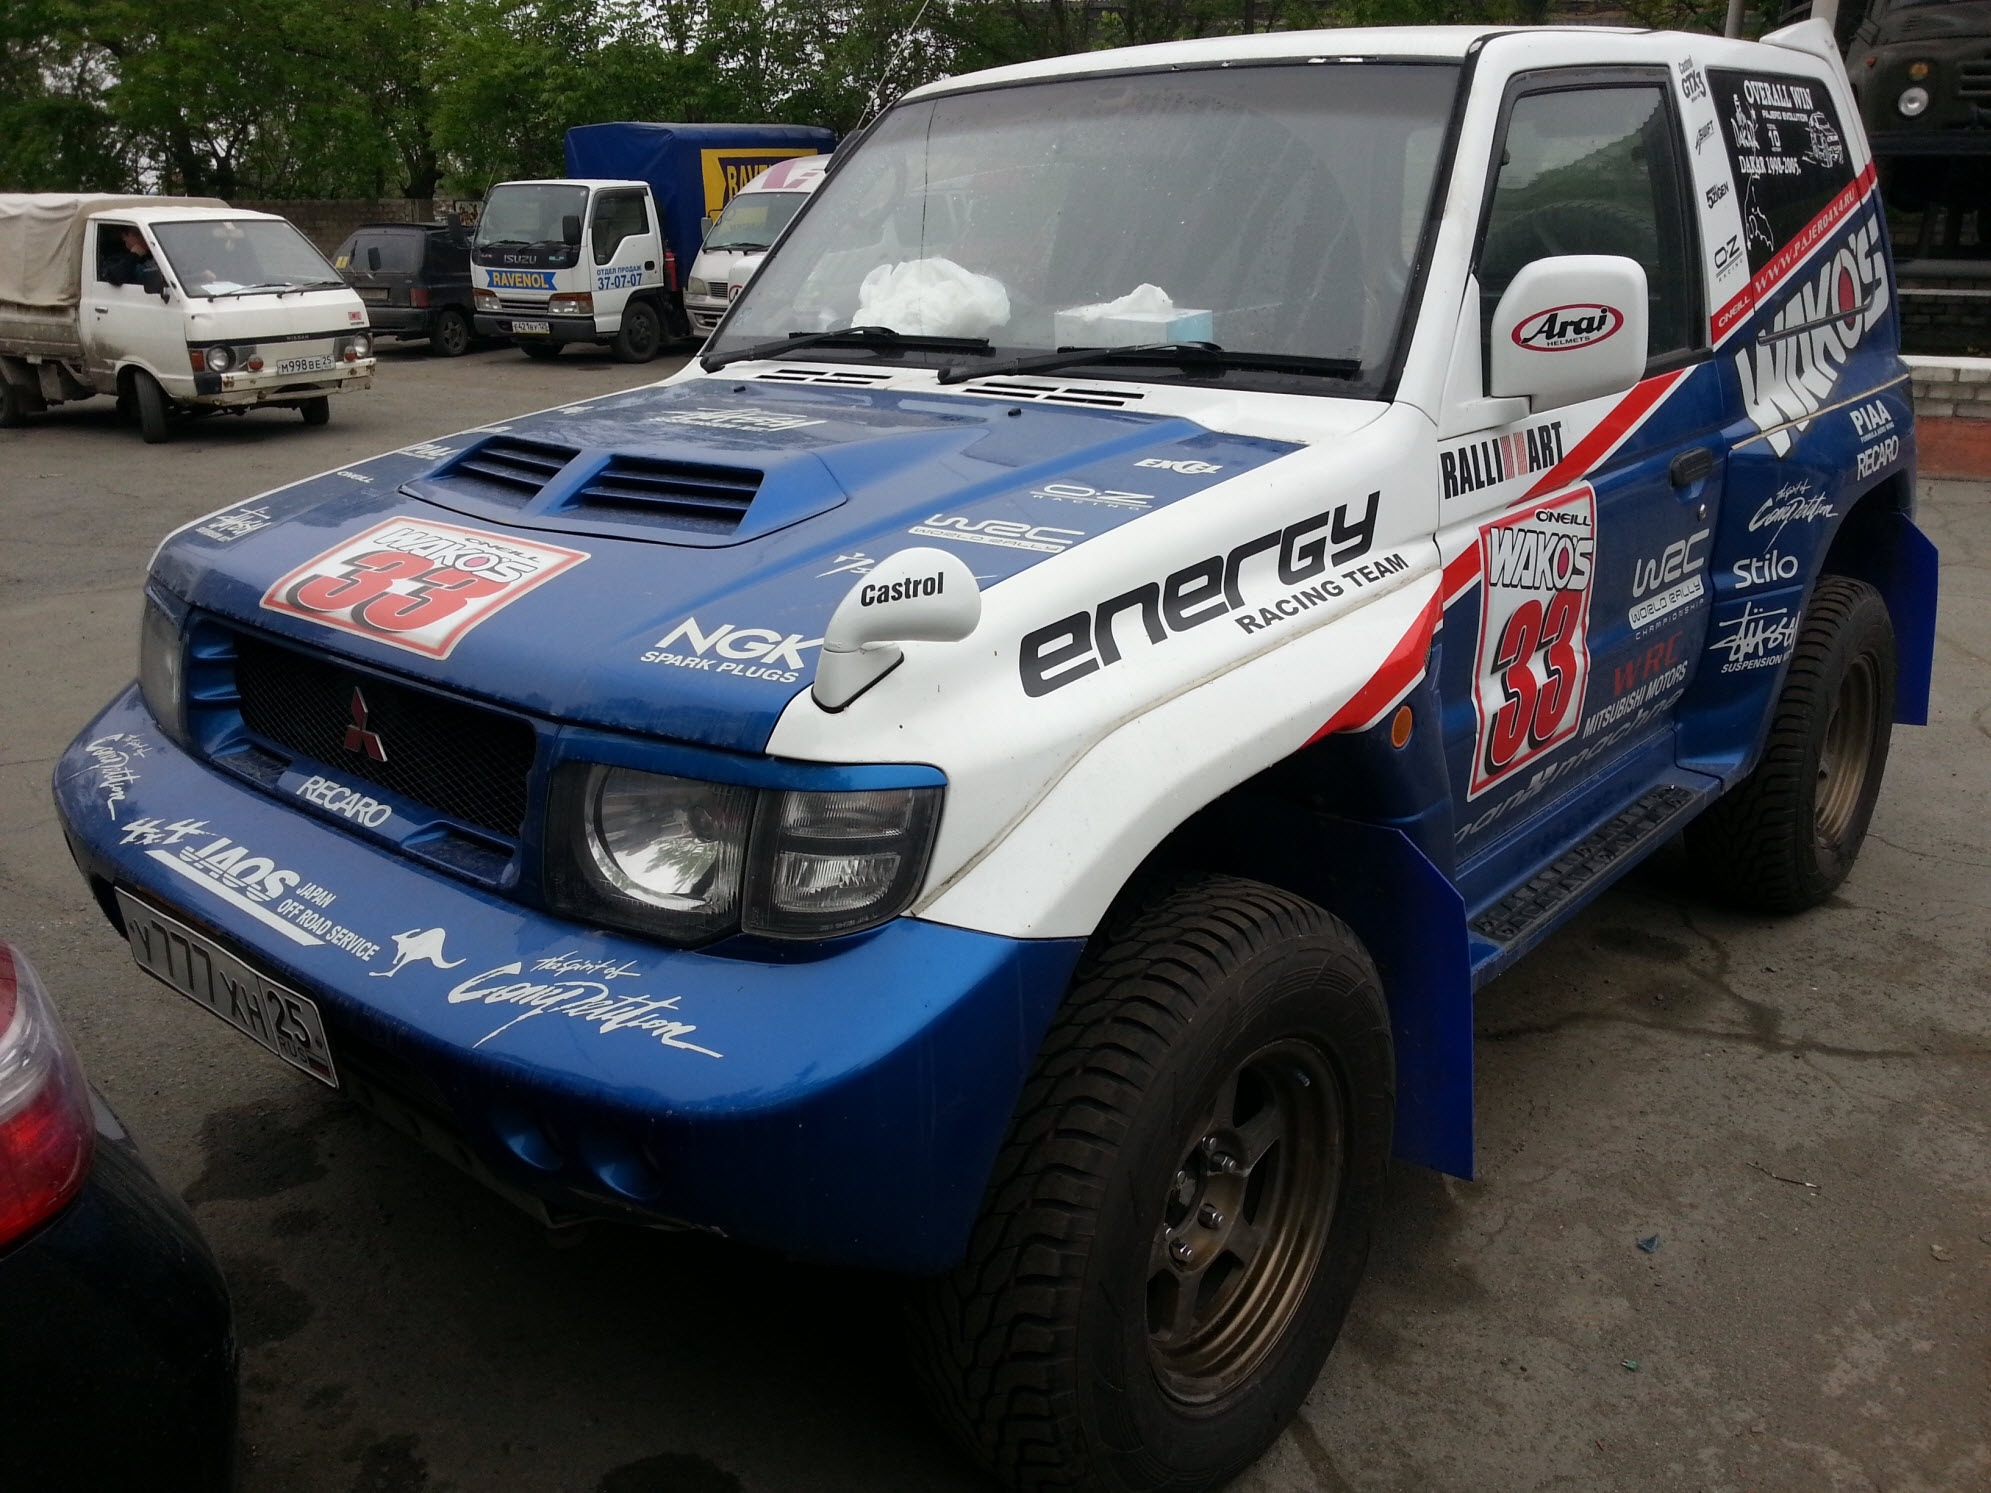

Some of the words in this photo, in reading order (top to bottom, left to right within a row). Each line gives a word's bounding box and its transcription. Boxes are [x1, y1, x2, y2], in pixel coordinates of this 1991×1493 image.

[1743, 80, 1792, 108] OVERALL
[1792, 87, 1814, 110] WIN
[1768, 130, 1781, 147] 10
[1738, 155, 1766, 174] DAKAR
[504, 254, 537, 265] ISUZU
[597, 267, 617, 276] ОТДЕЛ
[617, 264, 642, 275] ПРОДАЖ
[492, 271, 550, 289] RAVENOL
[597, 272, 643, 291] 37-07-07
[1521, 307, 1608, 344] Arai
[1546, 335, 1591, 347] HELMETS
[322, 356, 332, 365] 25
[1849, 400, 1892, 436] PIAA
[1857, 435, 1899, 480] RECARO
[914, 527, 984, 542] WORLD
[988, 538, 1061, 552] RALLY
[924, 514, 1085, 545] WRC
[1488, 526, 1594, 592] WAKO'S
[1632, 528, 1710, 598] WRC
[1733, 549, 1799, 589] Stilo
[286, 550, 512, 633] 33
[860, 571, 944, 607] Castrol
[1235, 580, 1345, 635] RACING
[1340, 553, 1410, 588] TEAM
[1630, 597, 1668, 624] WORLD
[1668, 580, 1702, 604] RALLY
[1635, 598, 1704, 640] CHAMPIONSHIP
[654, 616, 825, 670] NGK
[640, 651, 717, 671] SPARK
[716, 661, 800, 683] PLUGS
[1720, 653, 1783, 673] SUSPENSION
[1483, 591, 1584, 776] 33
[1582, 684, 1647, 740] MITSUBISHI
[1644, 659, 1689, 702] MOTORS
[295, 775, 393, 828] RECARO
[179, 837, 301, 902] JAOS
[295, 881, 338, 909] JAPAN
[277, 899, 302, 922] OFF
[299, 908, 332, 942] ROAD
[325, 925, 381, 961] SERVICE
[267, 989, 312, 1049] 25
